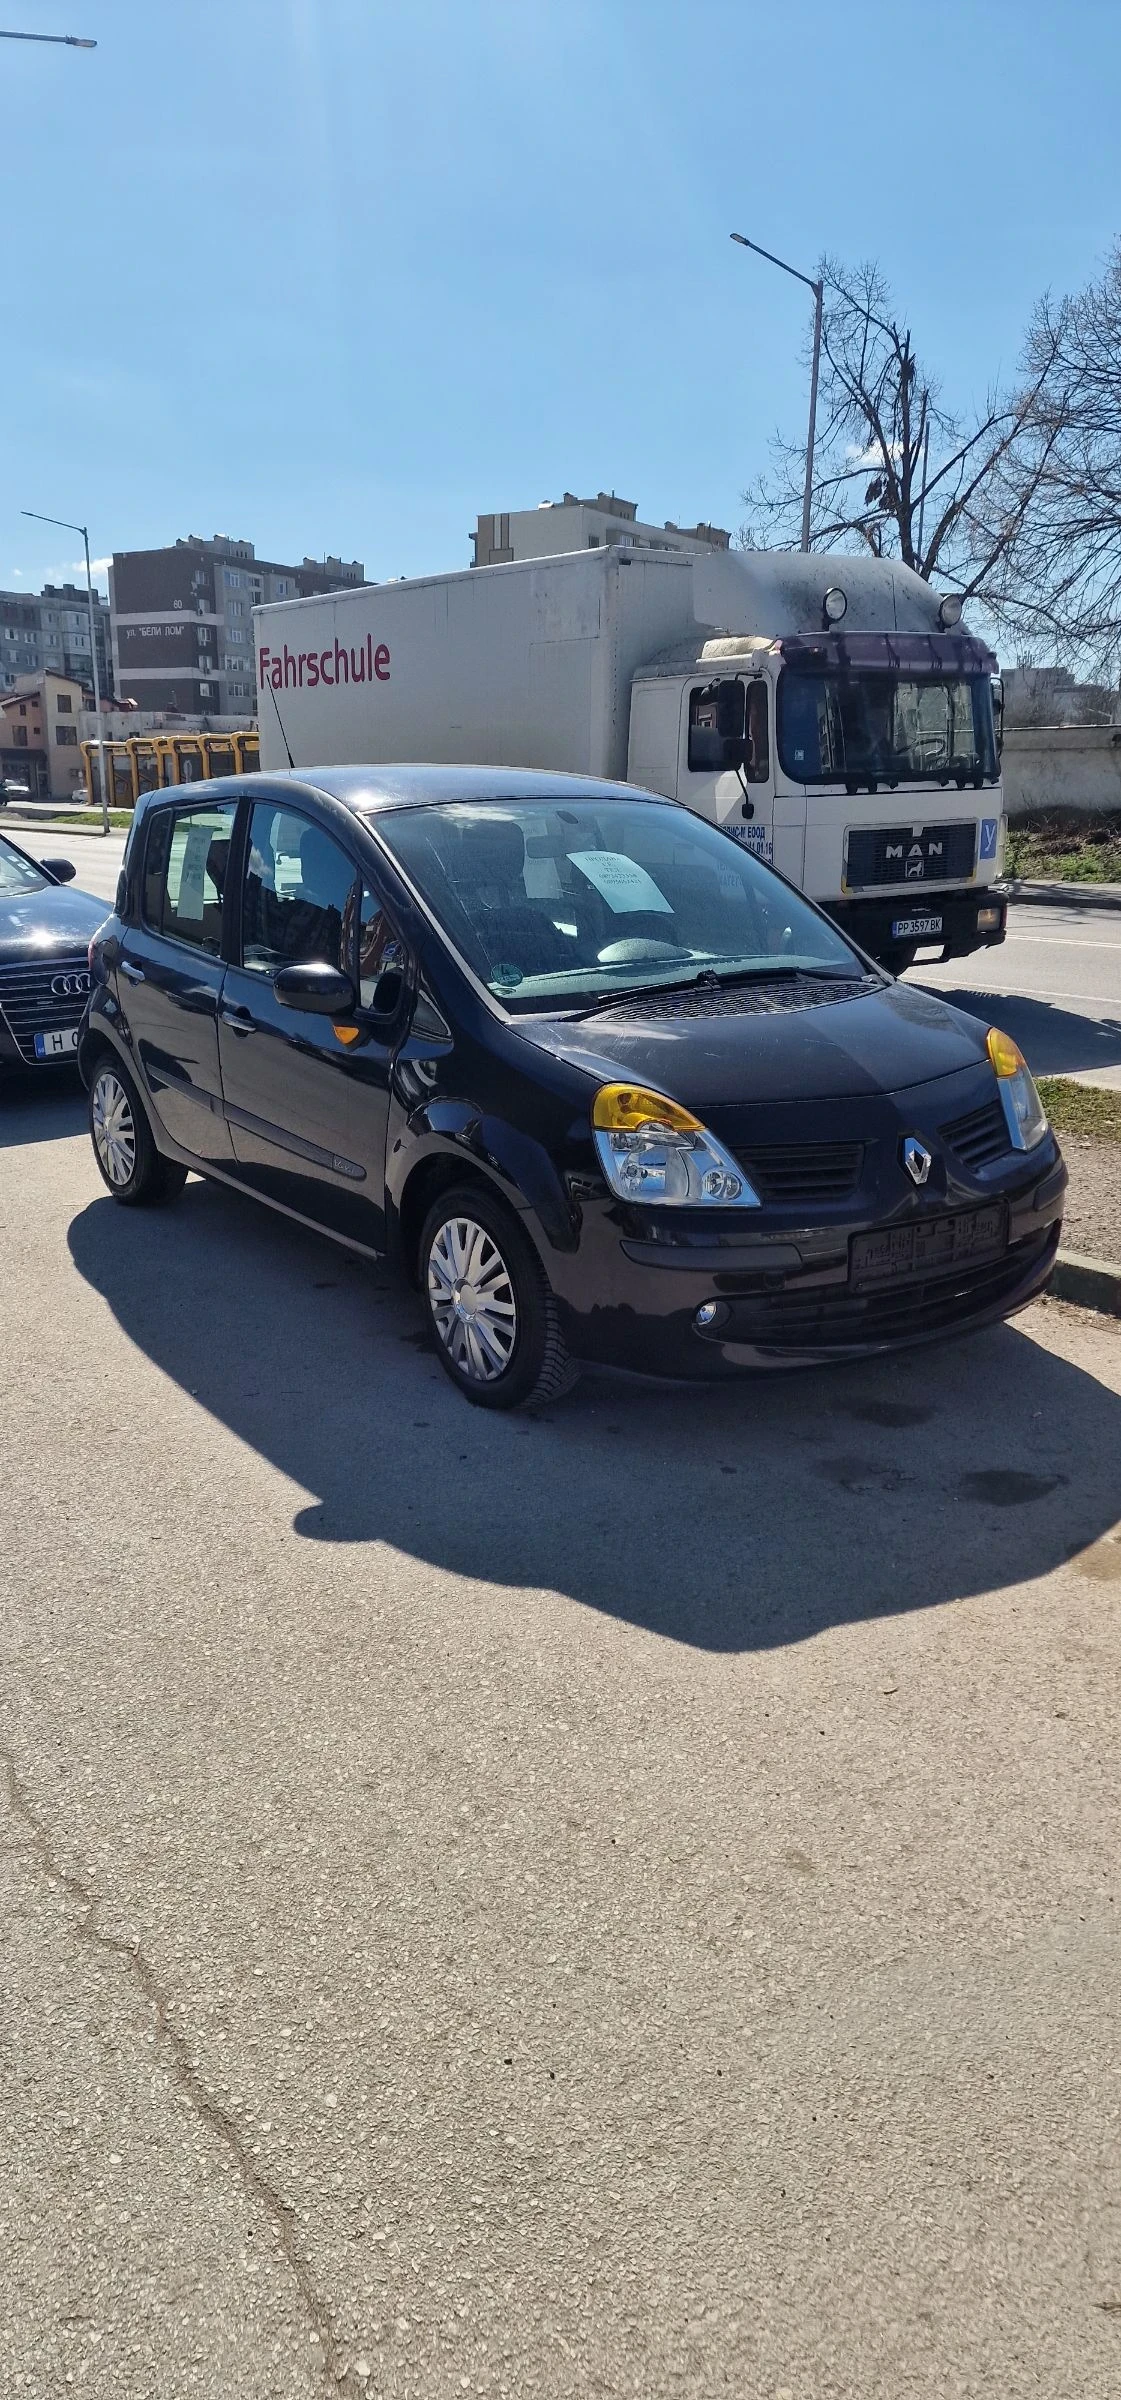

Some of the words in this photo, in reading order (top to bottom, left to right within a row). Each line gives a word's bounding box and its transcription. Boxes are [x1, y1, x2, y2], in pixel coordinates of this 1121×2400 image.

[259, 633, 391, 690] Fahrschule
[885, 842, 943, 859] MAN
[910, 920, 929, 932] 3597
[930, 919, 941, 930] BK
